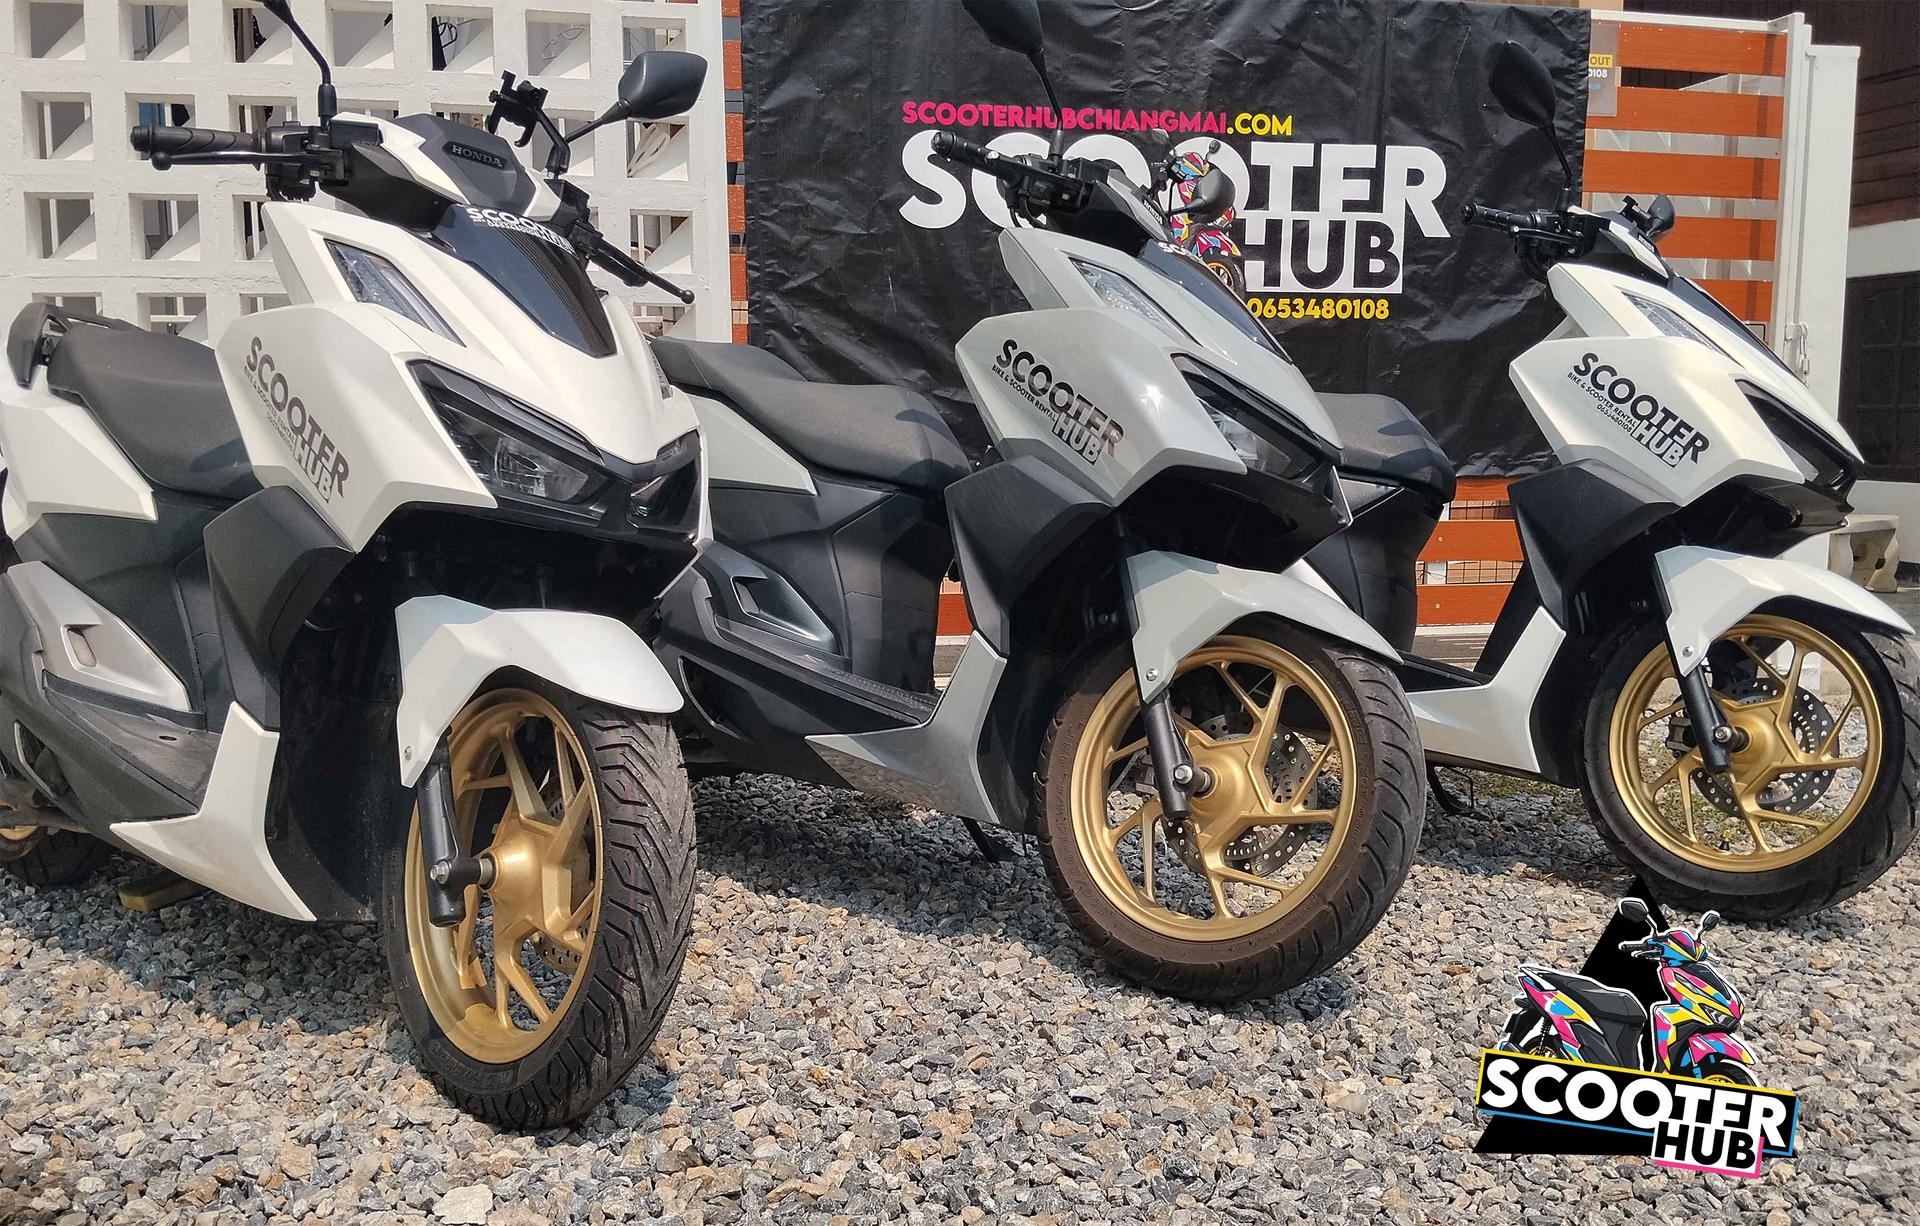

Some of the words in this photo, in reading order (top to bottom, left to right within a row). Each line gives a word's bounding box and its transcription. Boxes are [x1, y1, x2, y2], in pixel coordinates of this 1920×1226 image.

[1590, 56, 1611, 66] OUT
[902, 101, 1293, 136] SCOOTERHUBCHIANGMAI.COM
[452, 144, 503, 168] HONDA
[1143, 199, 1163, 225] HONDA
[1231, 218, 1401, 290] HUB
[1246, 297, 1390, 320] 0653480108
[246, 336, 350, 499] SCOOTER
[992, 364, 1005, 378] BIKE
[1009, 379, 1035, 404] SCOOTER
[1034, 400, 1056, 422] RENTAL
[996, 338, 1124, 458] SCOOTER
[1567, 371, 1581, 385] BIKE
[1586, 385, 1614, 410] SCOOTER
[1613, 406, 1637, 427] RENTAL
[1573, 352, 1709, 464] SCOOTER
[1052, 411, 1102, 465] HUB
[1631, 419, 1684, 467] HUB
[293, 433, 333, 503] HUB
